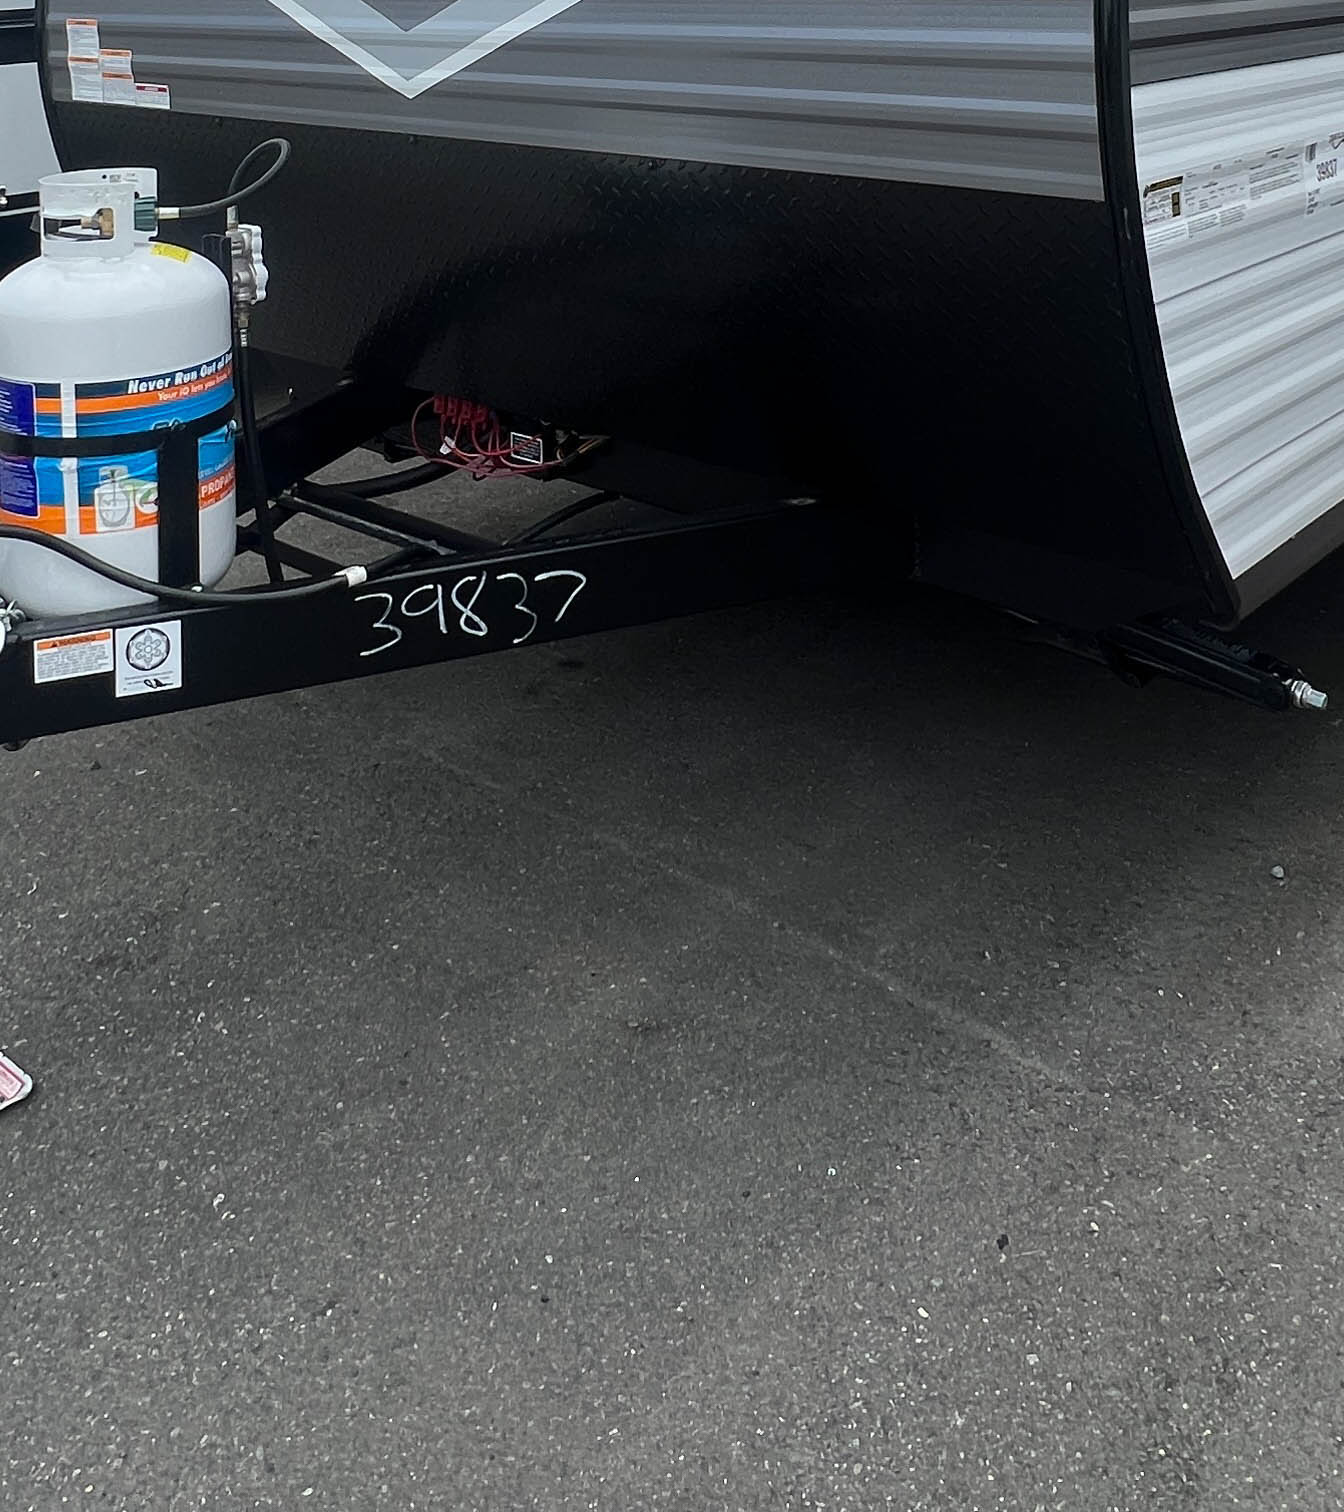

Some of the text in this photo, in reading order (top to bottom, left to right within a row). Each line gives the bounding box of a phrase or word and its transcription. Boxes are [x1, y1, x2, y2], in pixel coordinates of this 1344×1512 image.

[127, 377, 171, 394] Never
[174, 369, 197, 386] Run
[158, 389, 177, 401] Your
[354, 569, 587, 657] 39837
